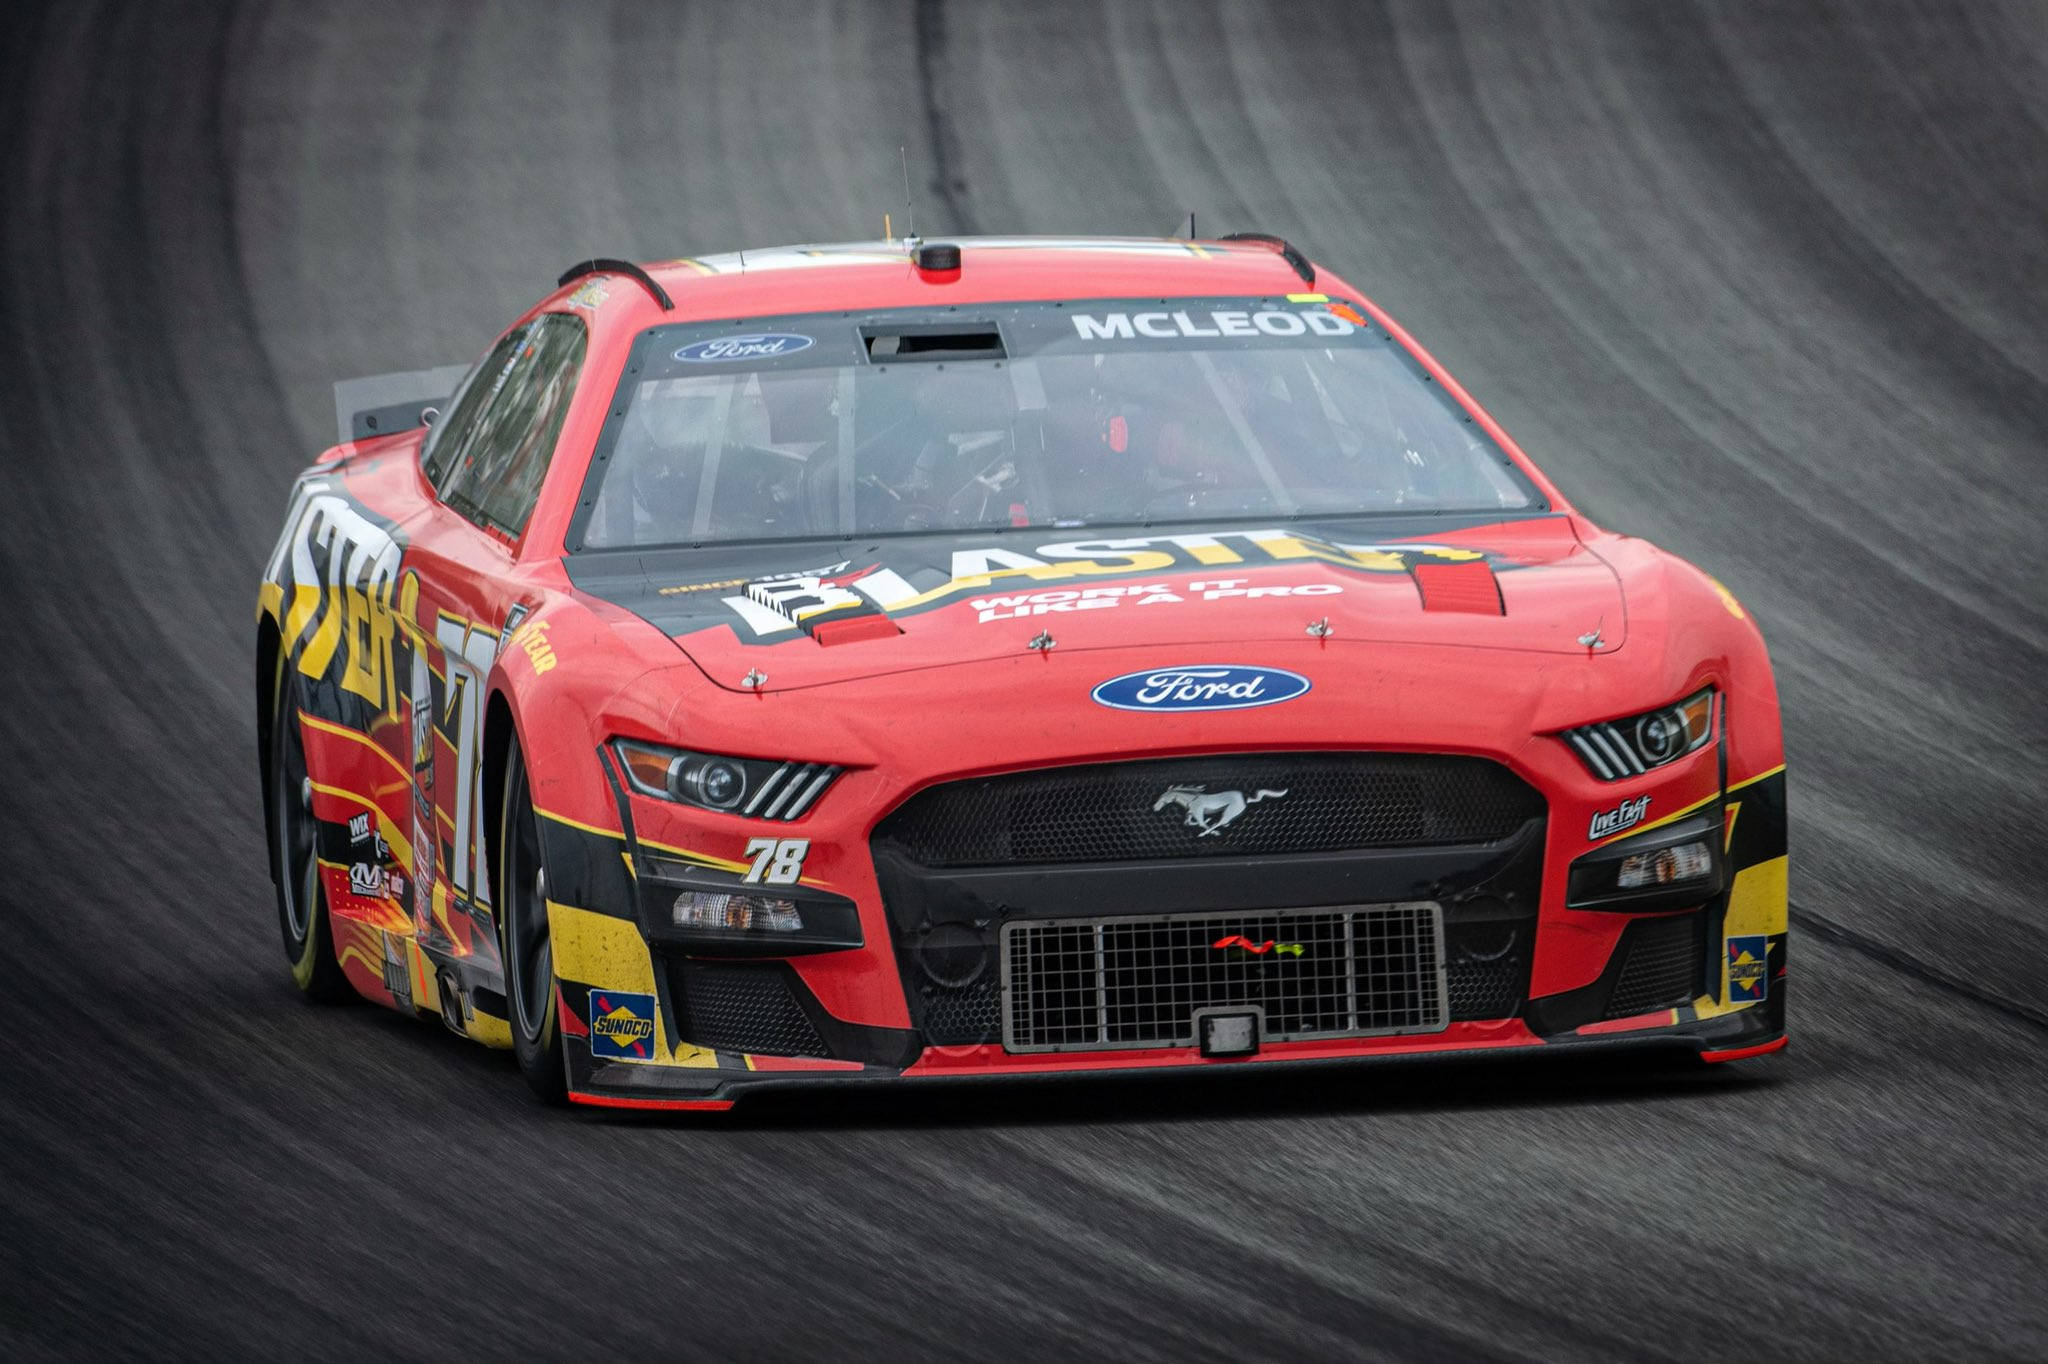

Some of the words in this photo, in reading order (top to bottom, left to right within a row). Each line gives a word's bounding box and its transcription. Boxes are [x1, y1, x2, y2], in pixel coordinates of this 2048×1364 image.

[1071, 309, 1354, 341] MCLEOD
[700, 335, 784, 360] Ford
[969, 582, 1179, 611] WORK
[1188, 578, 1249, 592] IT
[978, 596, 1120, 624] LIKE
[1136, 593, 1185, 606] A
[1203, 583, 1345, 601] PRO
[1136, 668, 1267, 705] Ford
[349, 812, 369, 838] WIX
[743, 838, 811, 886] 78
[595, 1015, 650, 1036] SUNOCO
